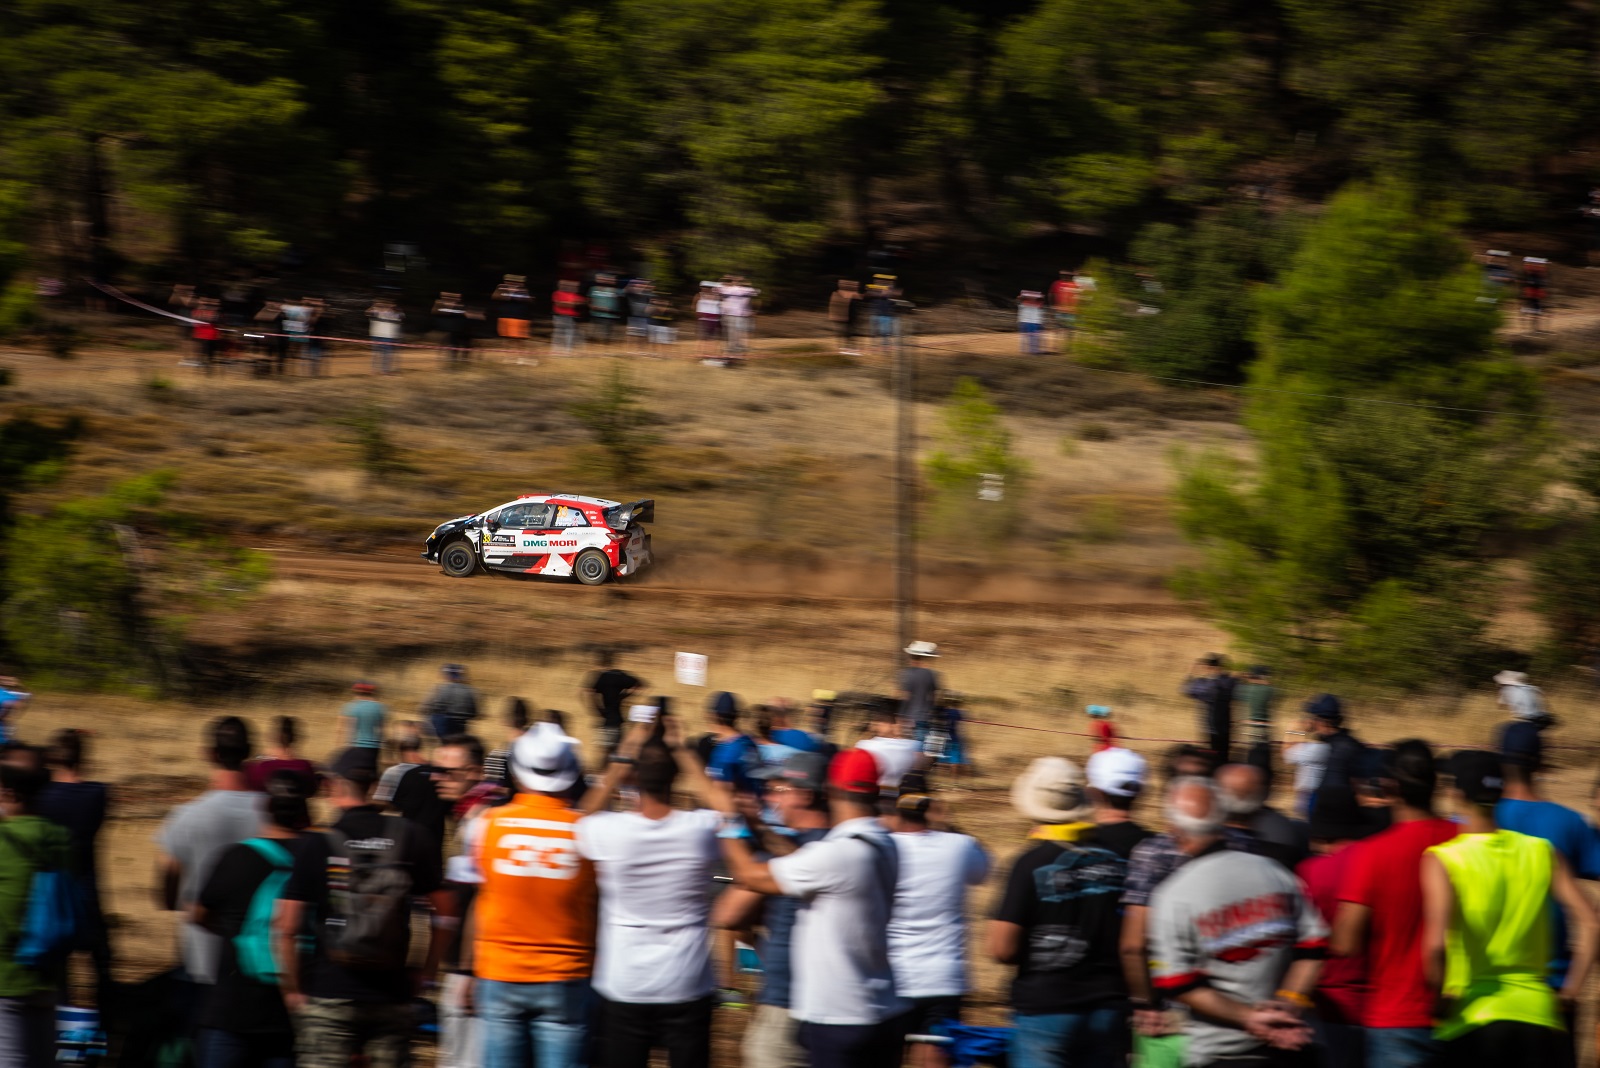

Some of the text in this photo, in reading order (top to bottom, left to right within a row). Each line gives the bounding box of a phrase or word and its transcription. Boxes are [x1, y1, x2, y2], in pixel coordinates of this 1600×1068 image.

[557, 505, 568, 517] 33
[482, 533, 491, 542] 33
[492, 833, 580, 880] 33
